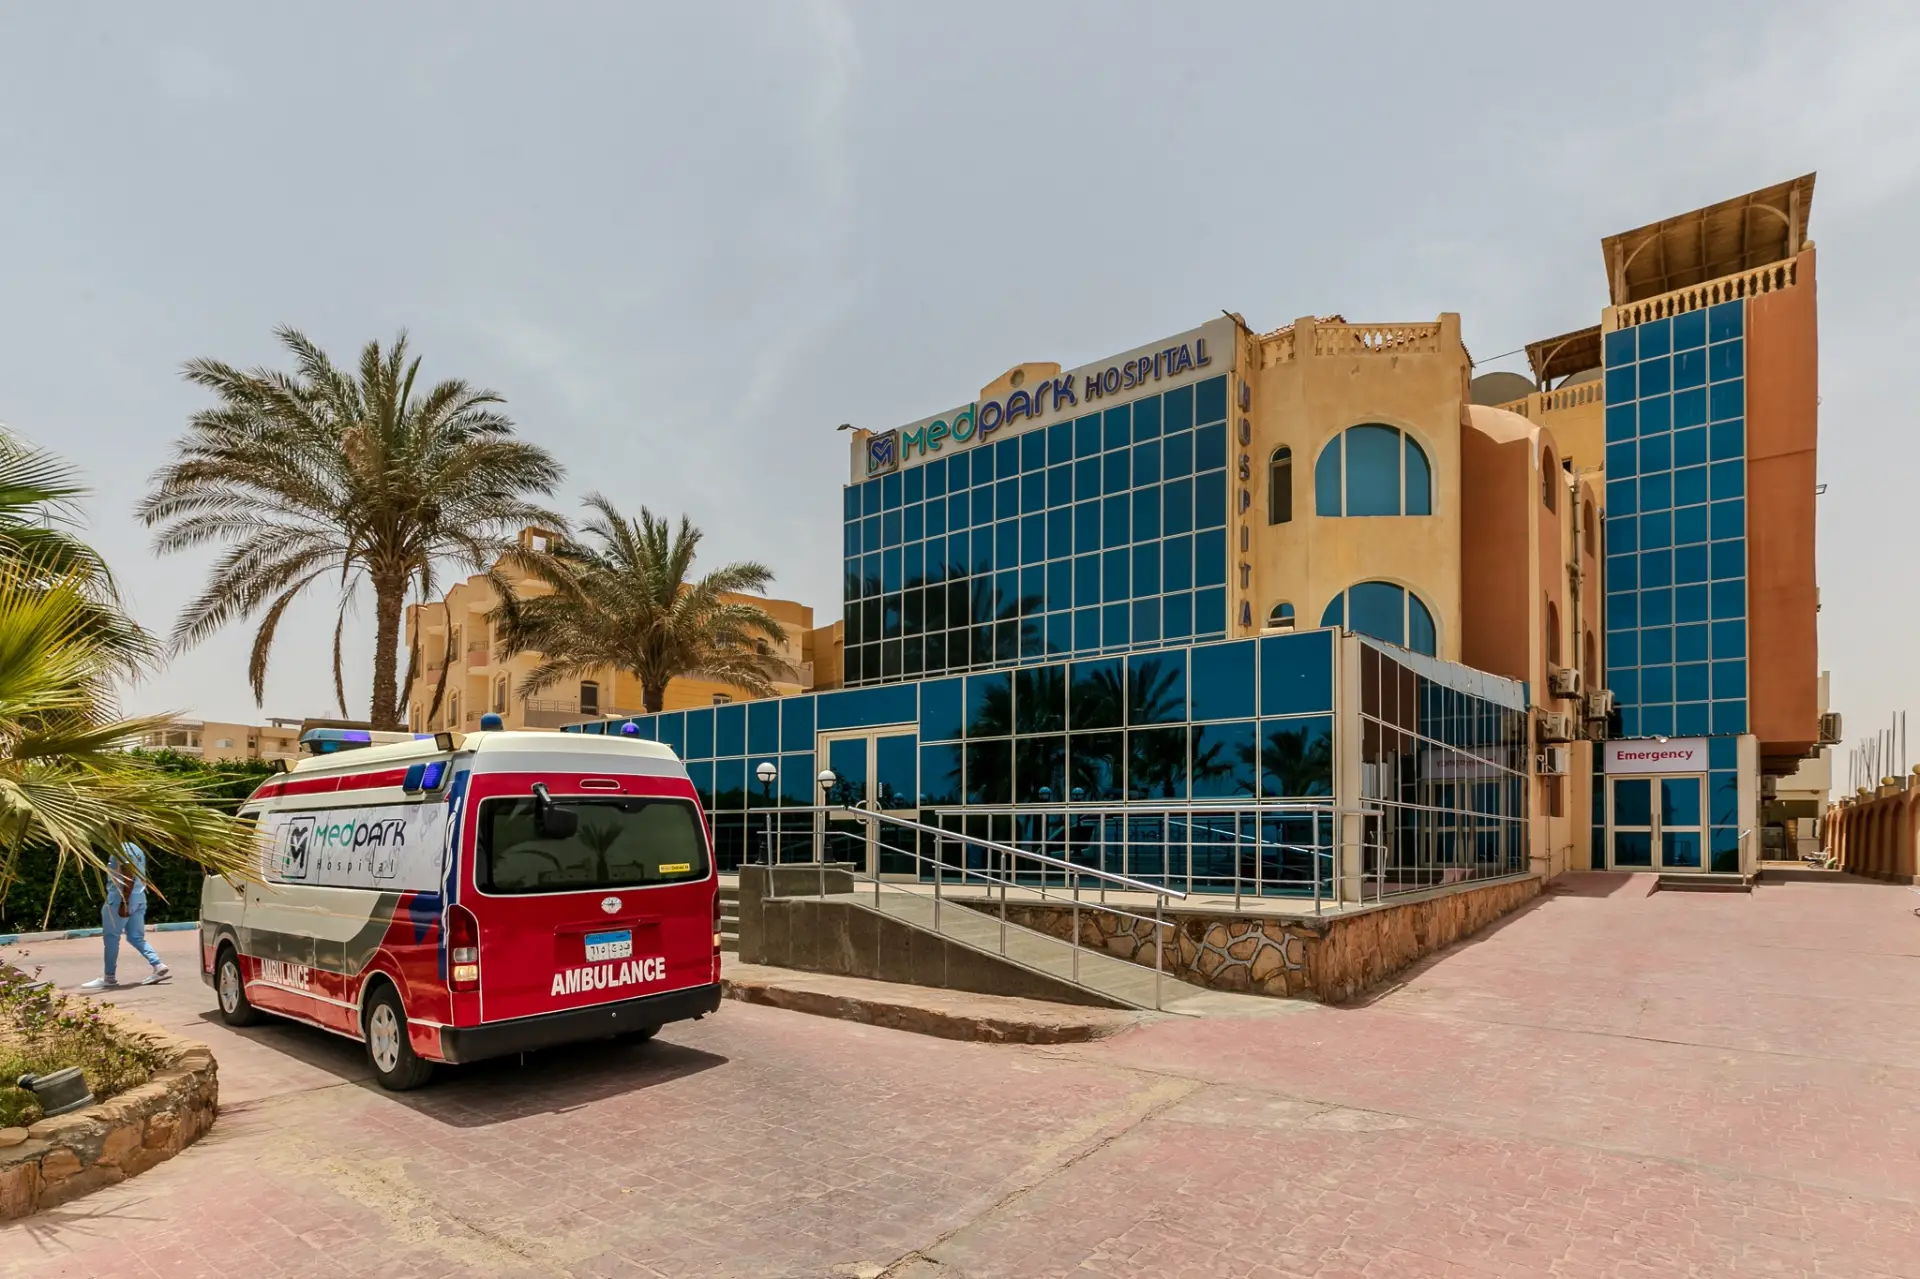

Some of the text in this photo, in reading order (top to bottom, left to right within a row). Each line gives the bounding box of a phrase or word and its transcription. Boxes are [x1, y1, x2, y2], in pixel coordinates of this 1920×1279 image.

[1084, 338, 1211, 401] HOSPITAL
[1238, 378, 1252, 628] HOSPITA
[1616, 750, 1693, 761] Emergency
[316, 859, 394, 873] Hospital
[261, 959, 310, 991] AMBULANCE
[551, 957, 666, 996] AMBULANCE
